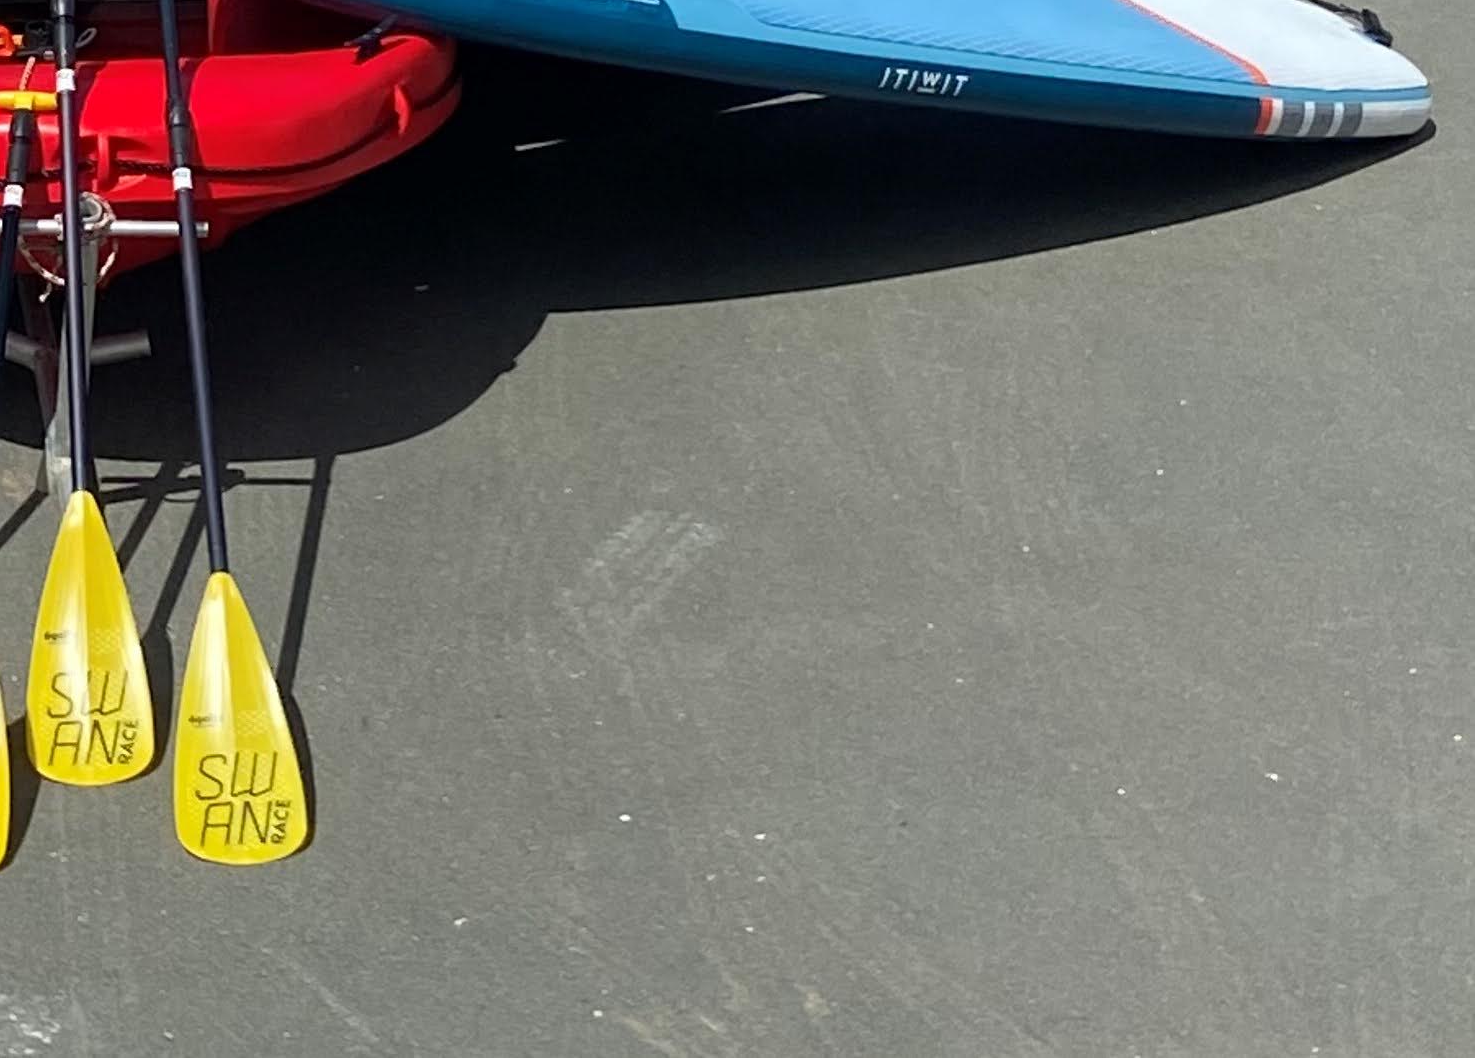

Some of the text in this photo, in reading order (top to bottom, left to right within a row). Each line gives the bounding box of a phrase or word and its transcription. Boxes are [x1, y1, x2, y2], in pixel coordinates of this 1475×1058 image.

[878, 66, 969, 97] ITIWIT
[117, 719, 140, 765] RACE
[199, 800, 272, 847] AN
[269, 800, 292, 845] RACE
